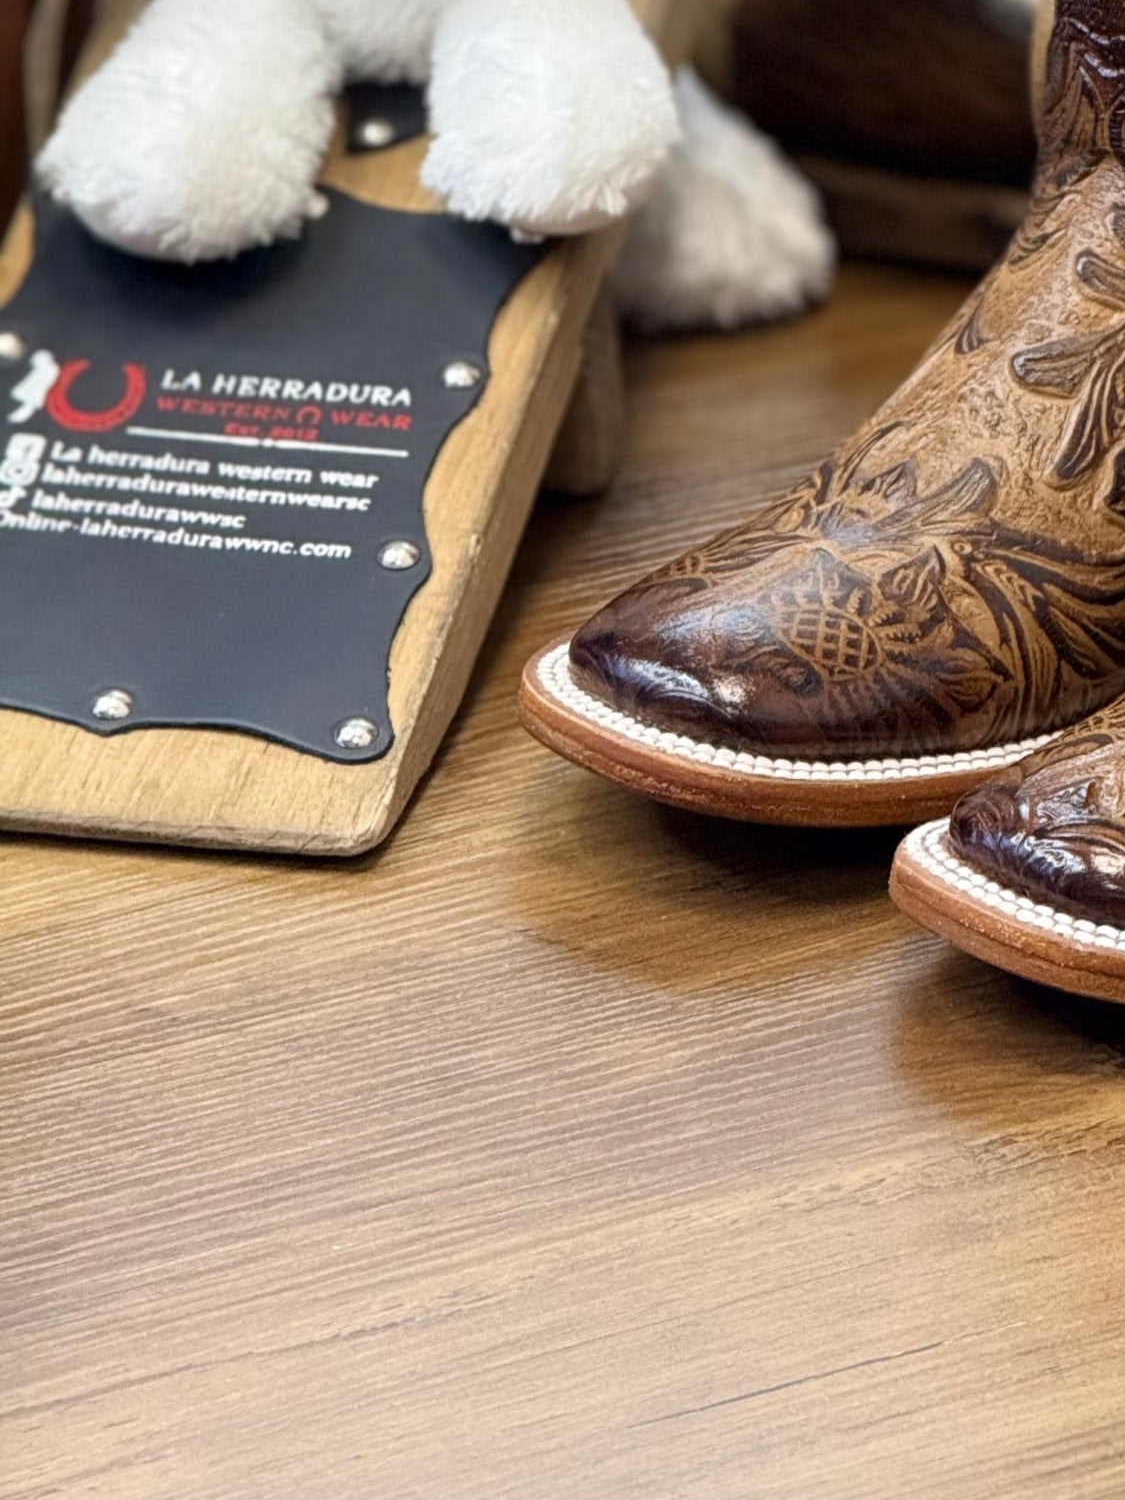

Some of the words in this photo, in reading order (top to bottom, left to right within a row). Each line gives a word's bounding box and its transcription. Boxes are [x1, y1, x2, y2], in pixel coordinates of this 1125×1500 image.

[160, 367, 201, 390] LA
[211, 373, 412, 407] HERRADURA
[156, 394, 291, 421] WESTERN
[331, 409, 412, 430] WEAR
[269, 424, 319, 442] 2012
[51, 440, 82, 463] La
[87, 444, 210, 475] herradura
[217, 461, 312, 484] western
[320, 470, 379, 489] wear
